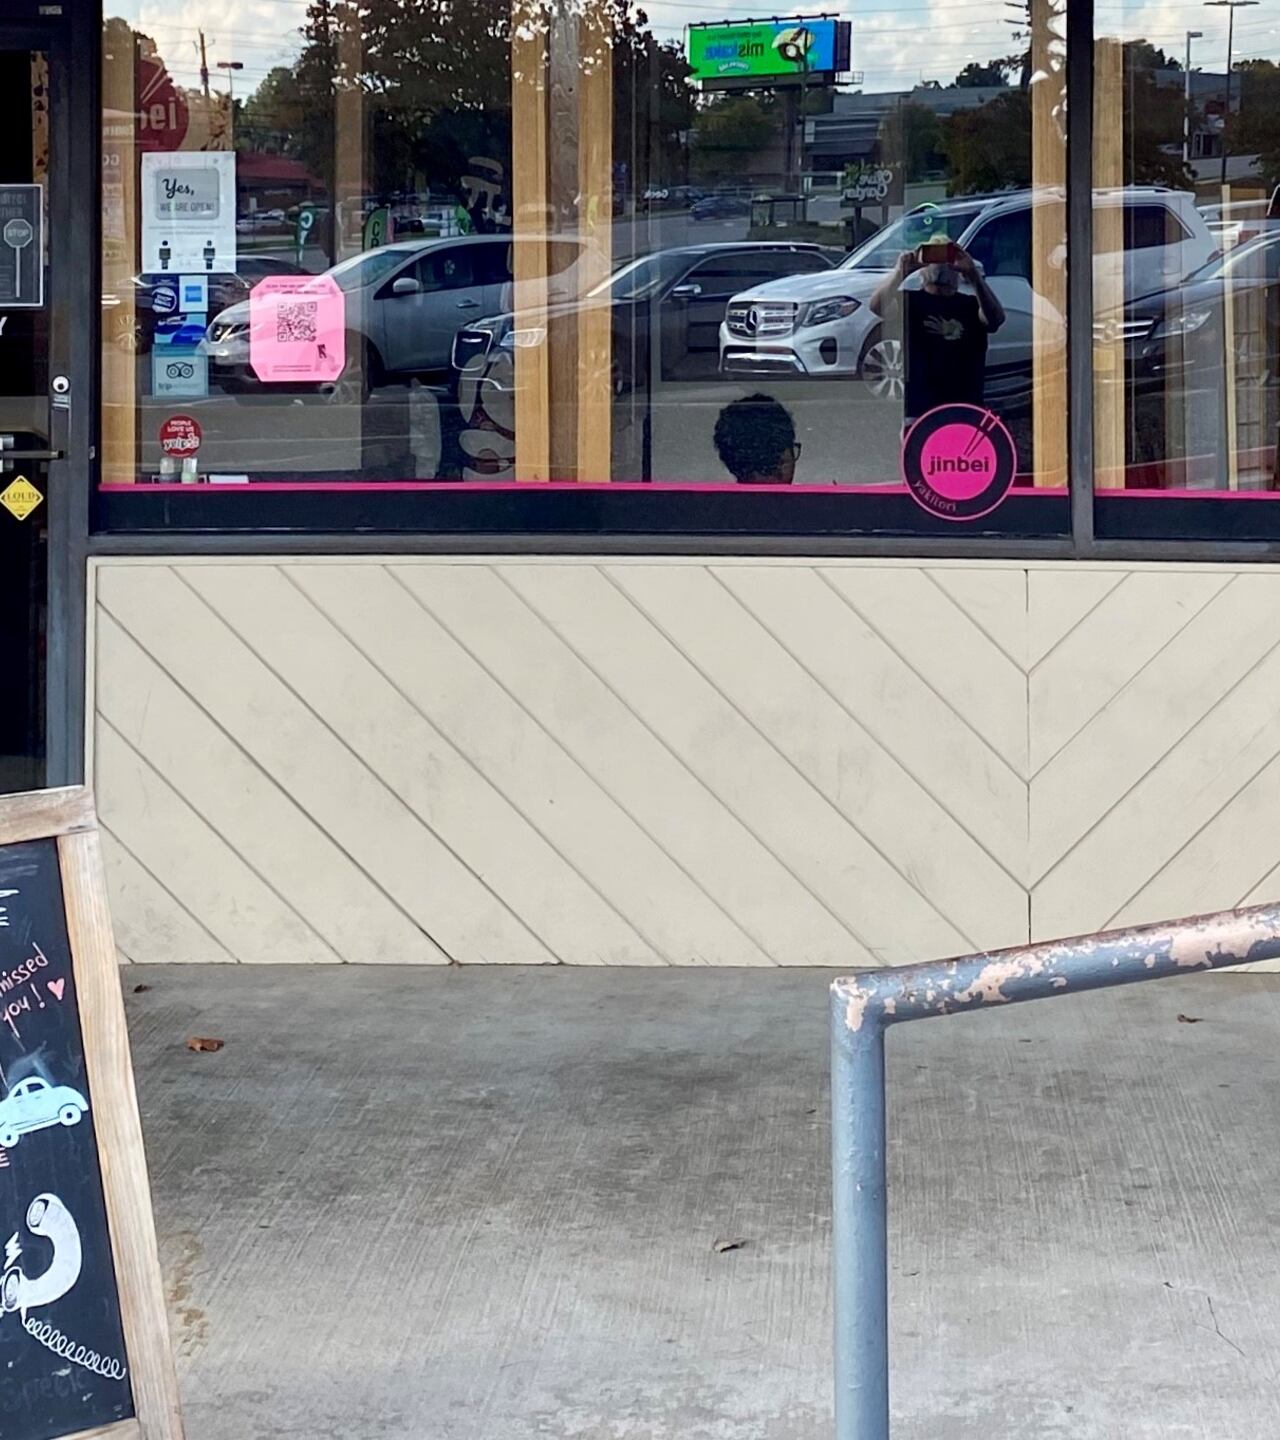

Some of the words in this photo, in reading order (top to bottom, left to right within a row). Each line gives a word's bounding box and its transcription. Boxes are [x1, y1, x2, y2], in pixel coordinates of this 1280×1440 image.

[162, 178, 194, 199] Yes,
[927, 456, 990, 476] jinbei
[912, 479, 956, 512] yakitori
